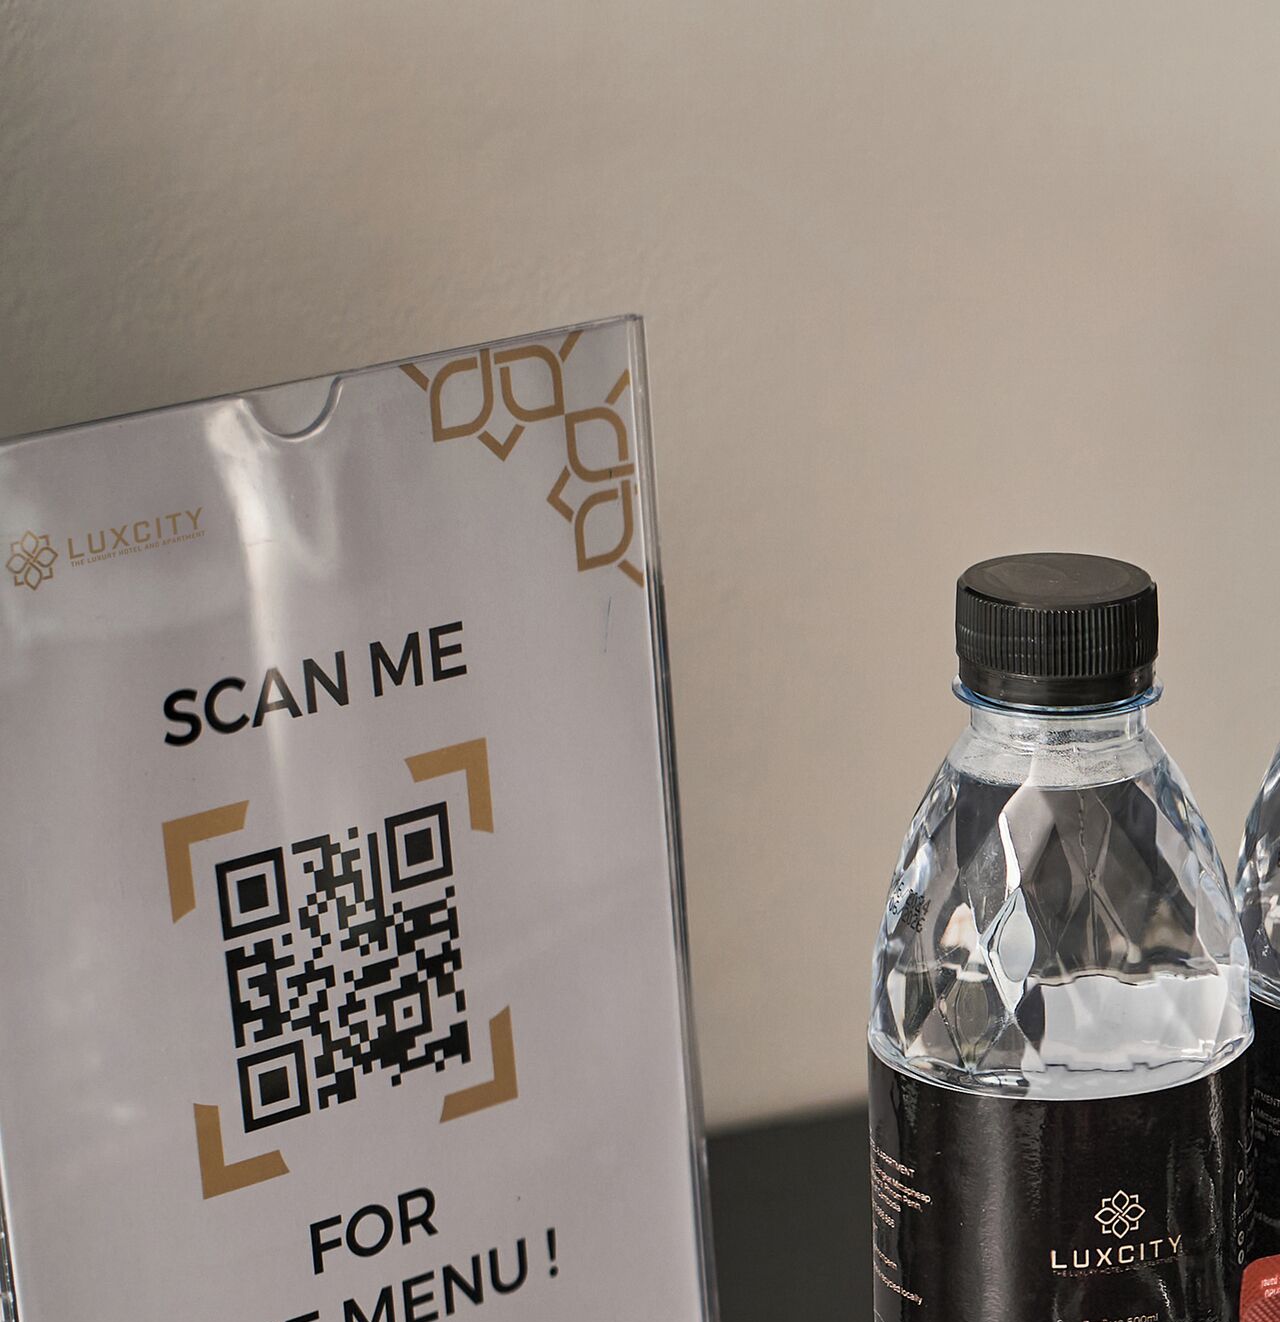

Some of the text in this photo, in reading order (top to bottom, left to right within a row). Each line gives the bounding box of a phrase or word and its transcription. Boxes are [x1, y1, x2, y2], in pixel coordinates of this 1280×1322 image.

[68, 507, 203, 560] LUXCITY
[163, 620, 467, 746] SCAN ME
[309, 1186, 439, 1275] FOR
[545, 1227, 559, 1279] !
[1051, 1235, 1182, 1269] LUXCITY
